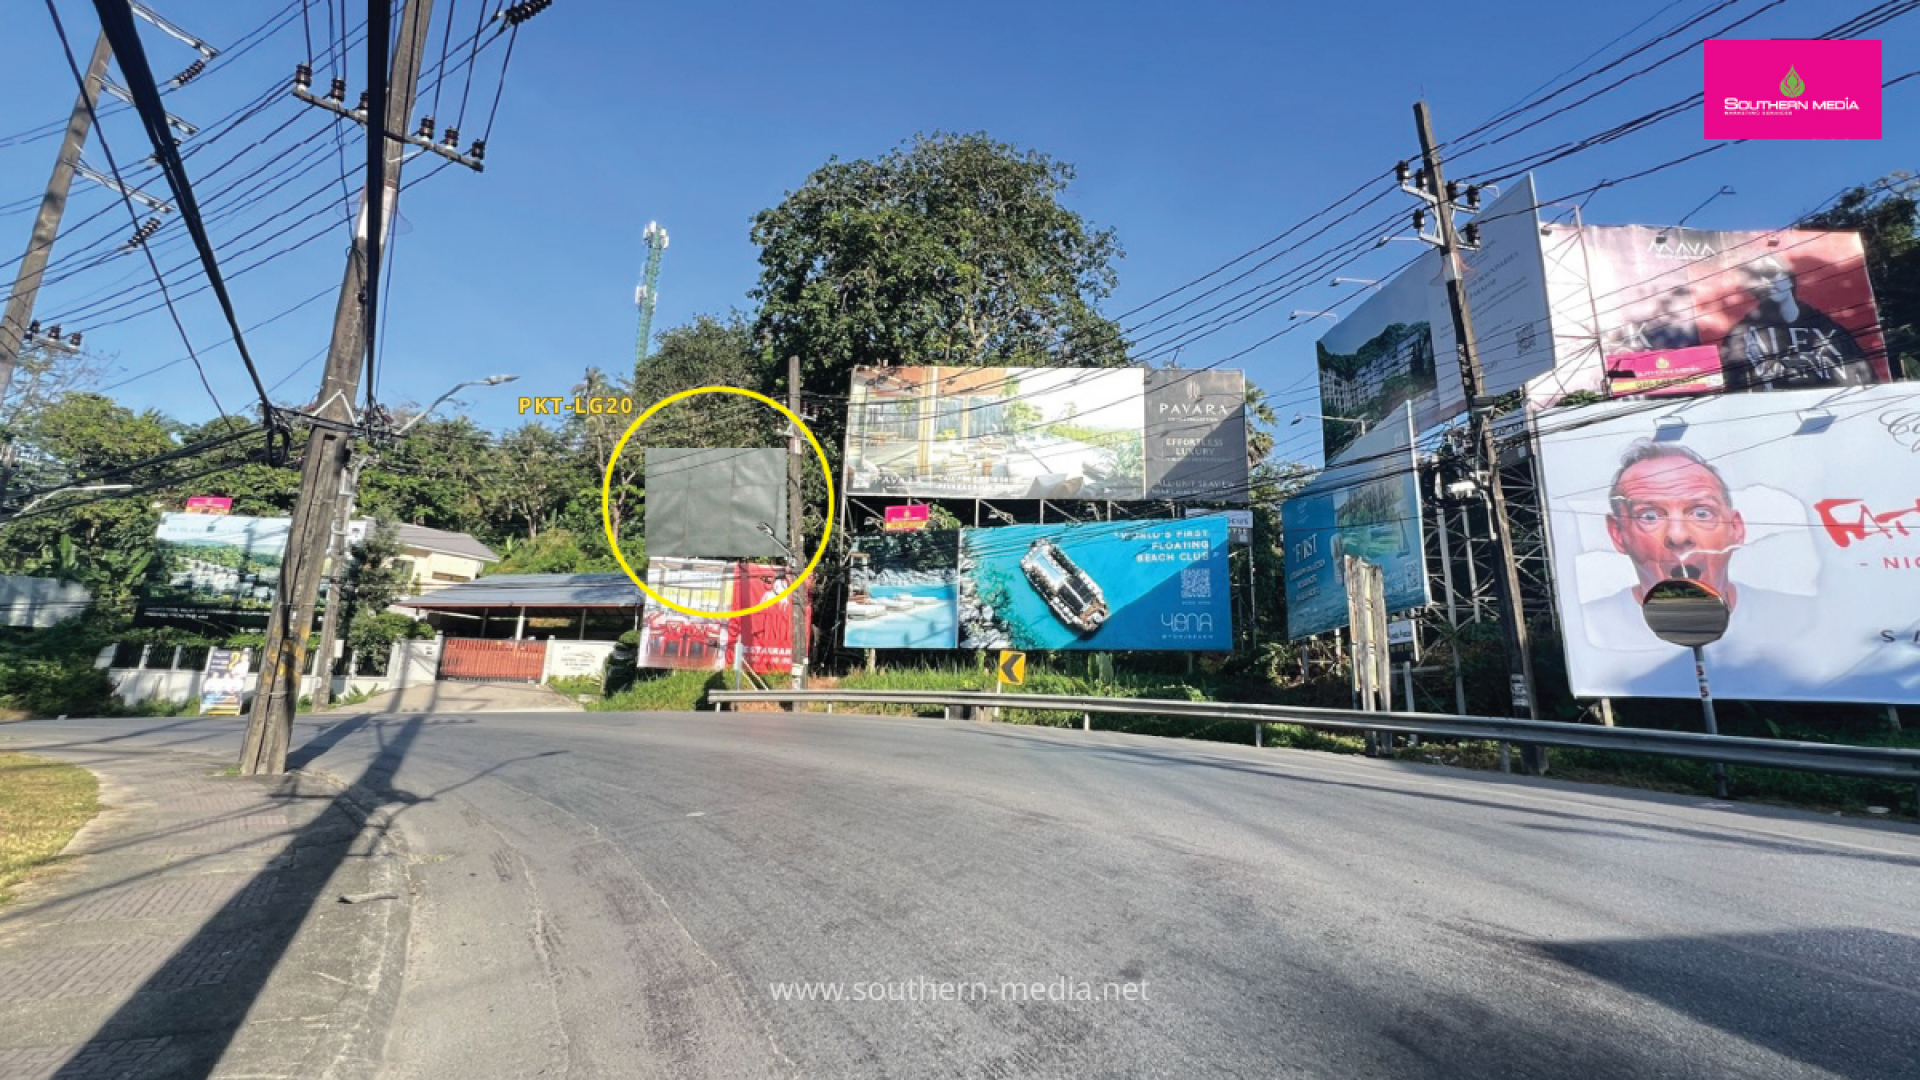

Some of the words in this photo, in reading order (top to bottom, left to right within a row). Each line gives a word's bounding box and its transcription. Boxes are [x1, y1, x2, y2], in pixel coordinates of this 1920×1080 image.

[1159, 402, 1228, 415] PAVARA
[1165, 438, 1223, 446] EFFORTLESS
[1175, 447, 1215, 455] LUXURY
[1176, 530, 1210, 539] FIRST
[1151, 540, 1210, 551] FLOATING
[1136, 553, 1175, 563] BEACH
